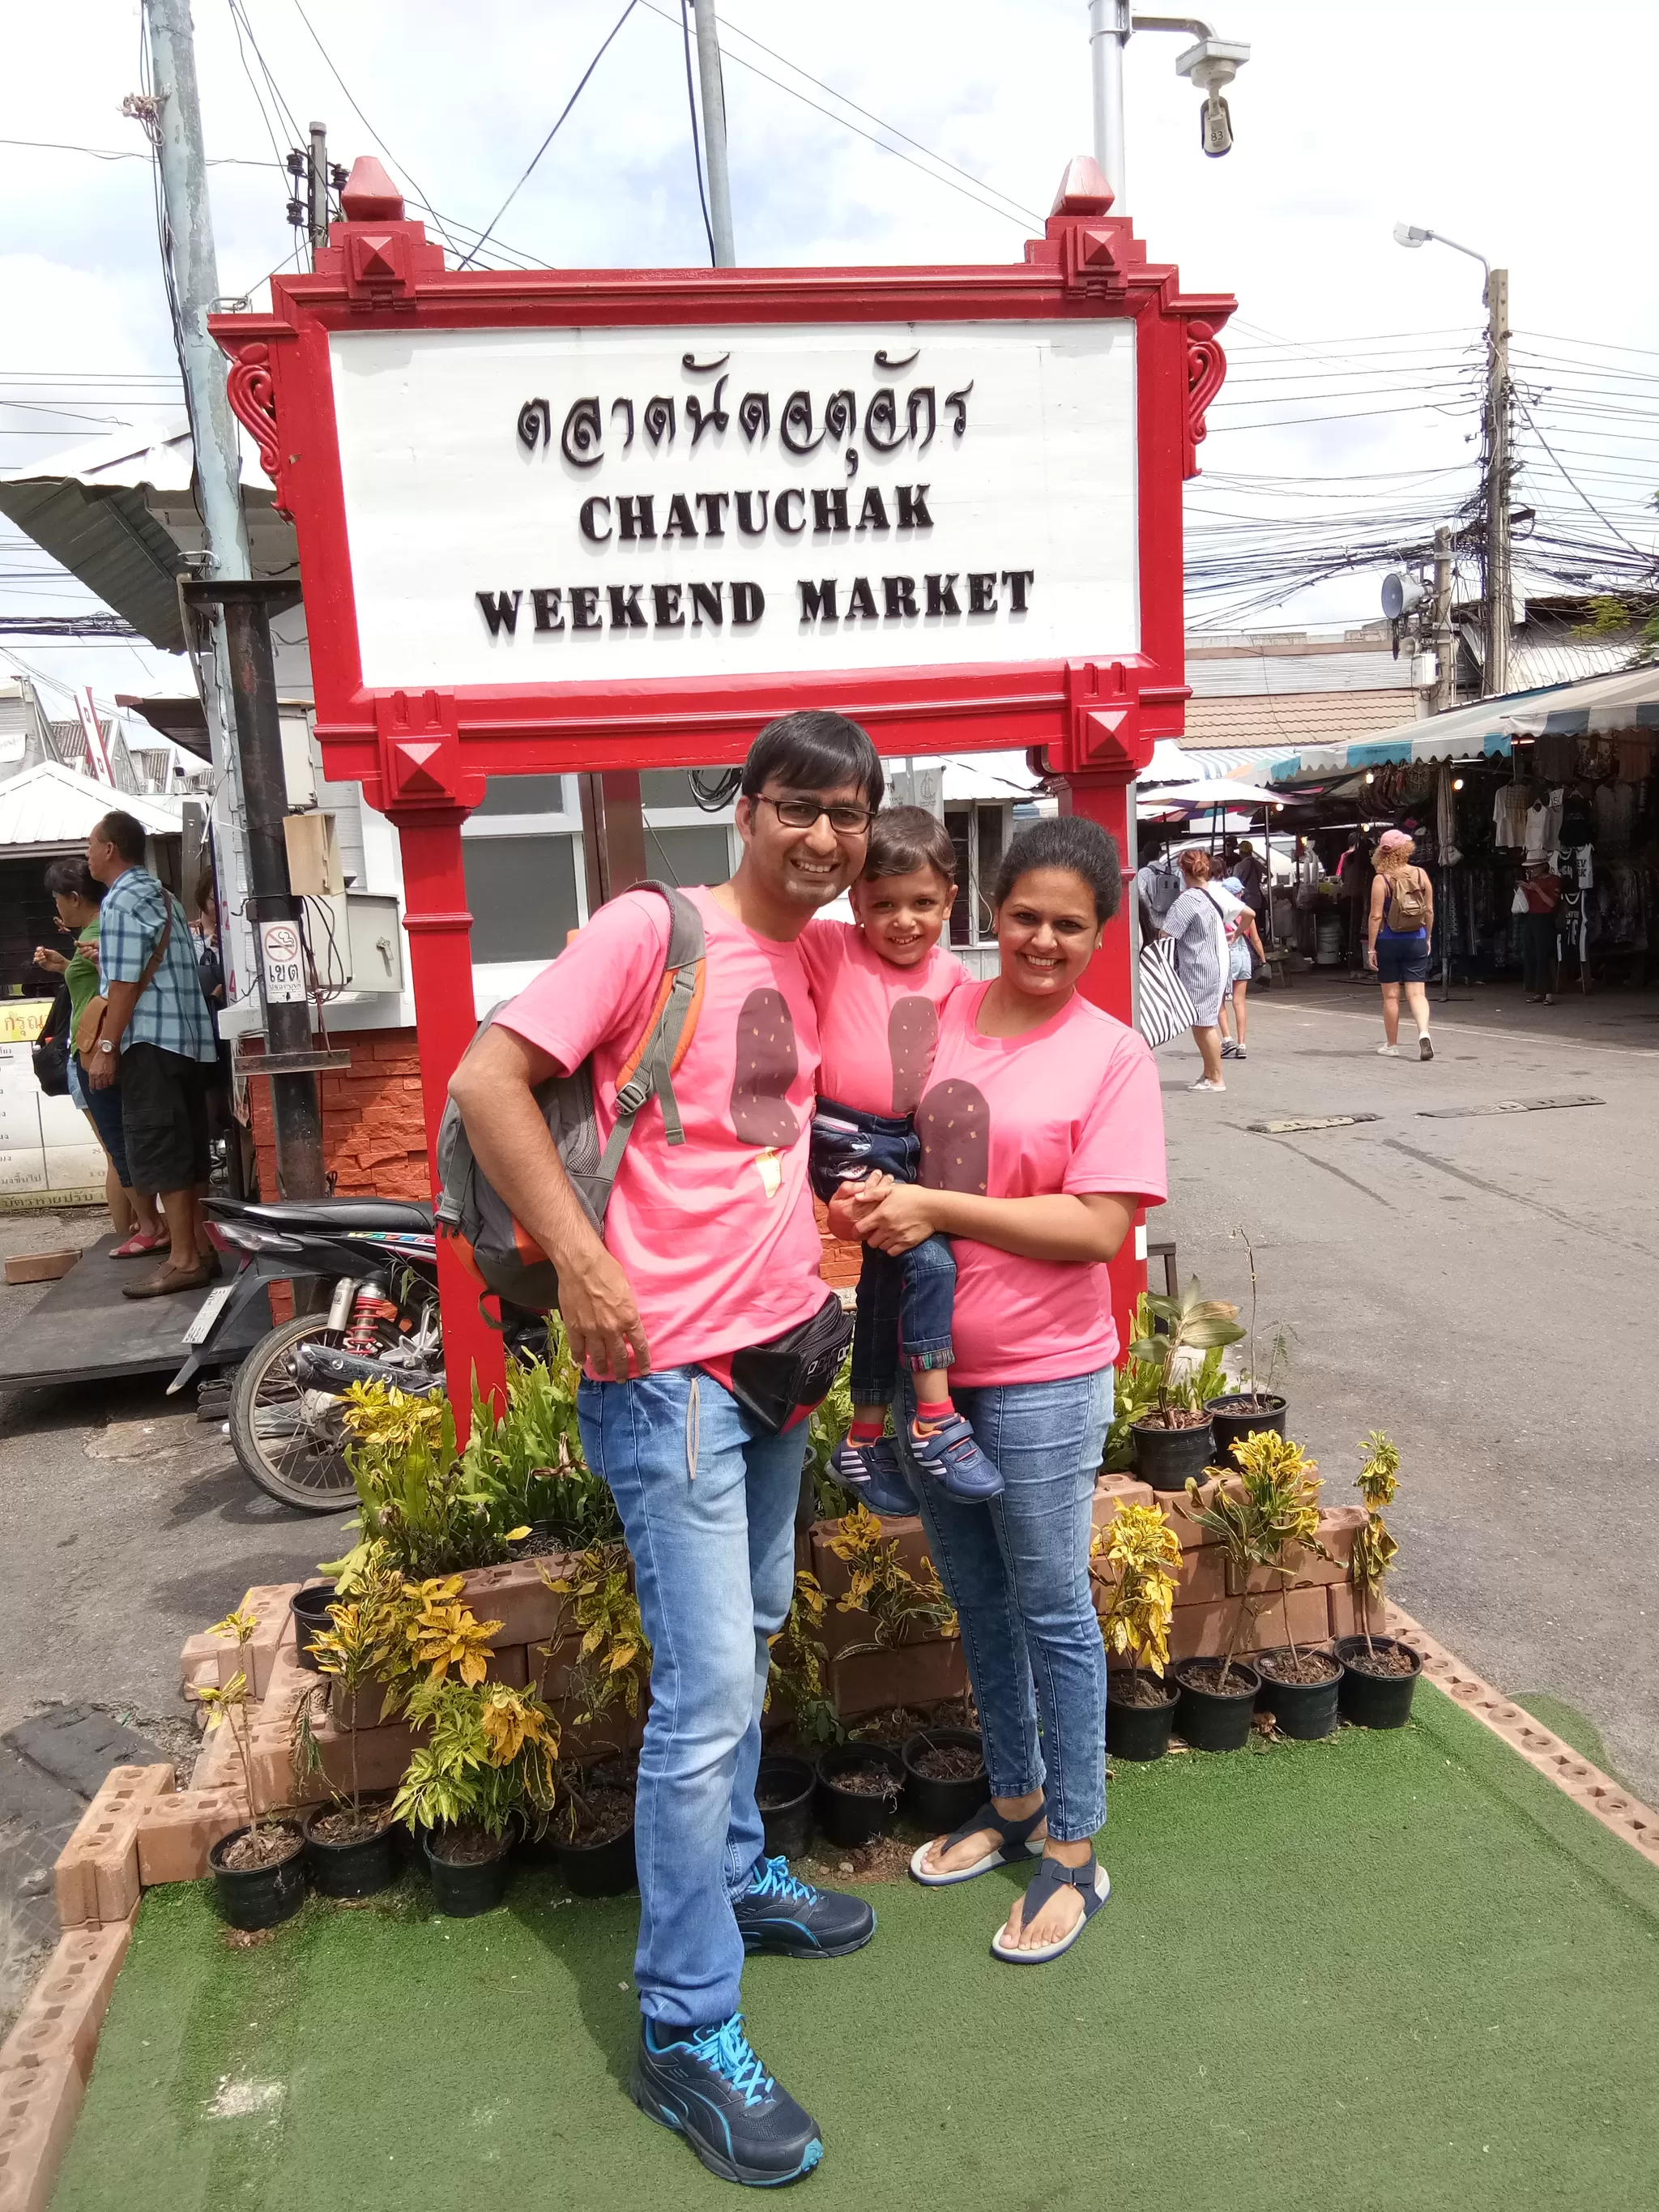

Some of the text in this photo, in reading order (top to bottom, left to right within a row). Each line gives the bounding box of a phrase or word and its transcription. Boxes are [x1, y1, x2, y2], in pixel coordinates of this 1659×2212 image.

[1211, 130, 1223, 142] 83
[518, 348, 974, 477] ตลาดนัดจตุจักร
[580, 484, 934, 542] CHATUCHAK
[476, 570, 1034, 636] WEEKEND MARKET
[269, 964, 299, 983] เขต
[4, 1014, 49, 1037] กรุณ
